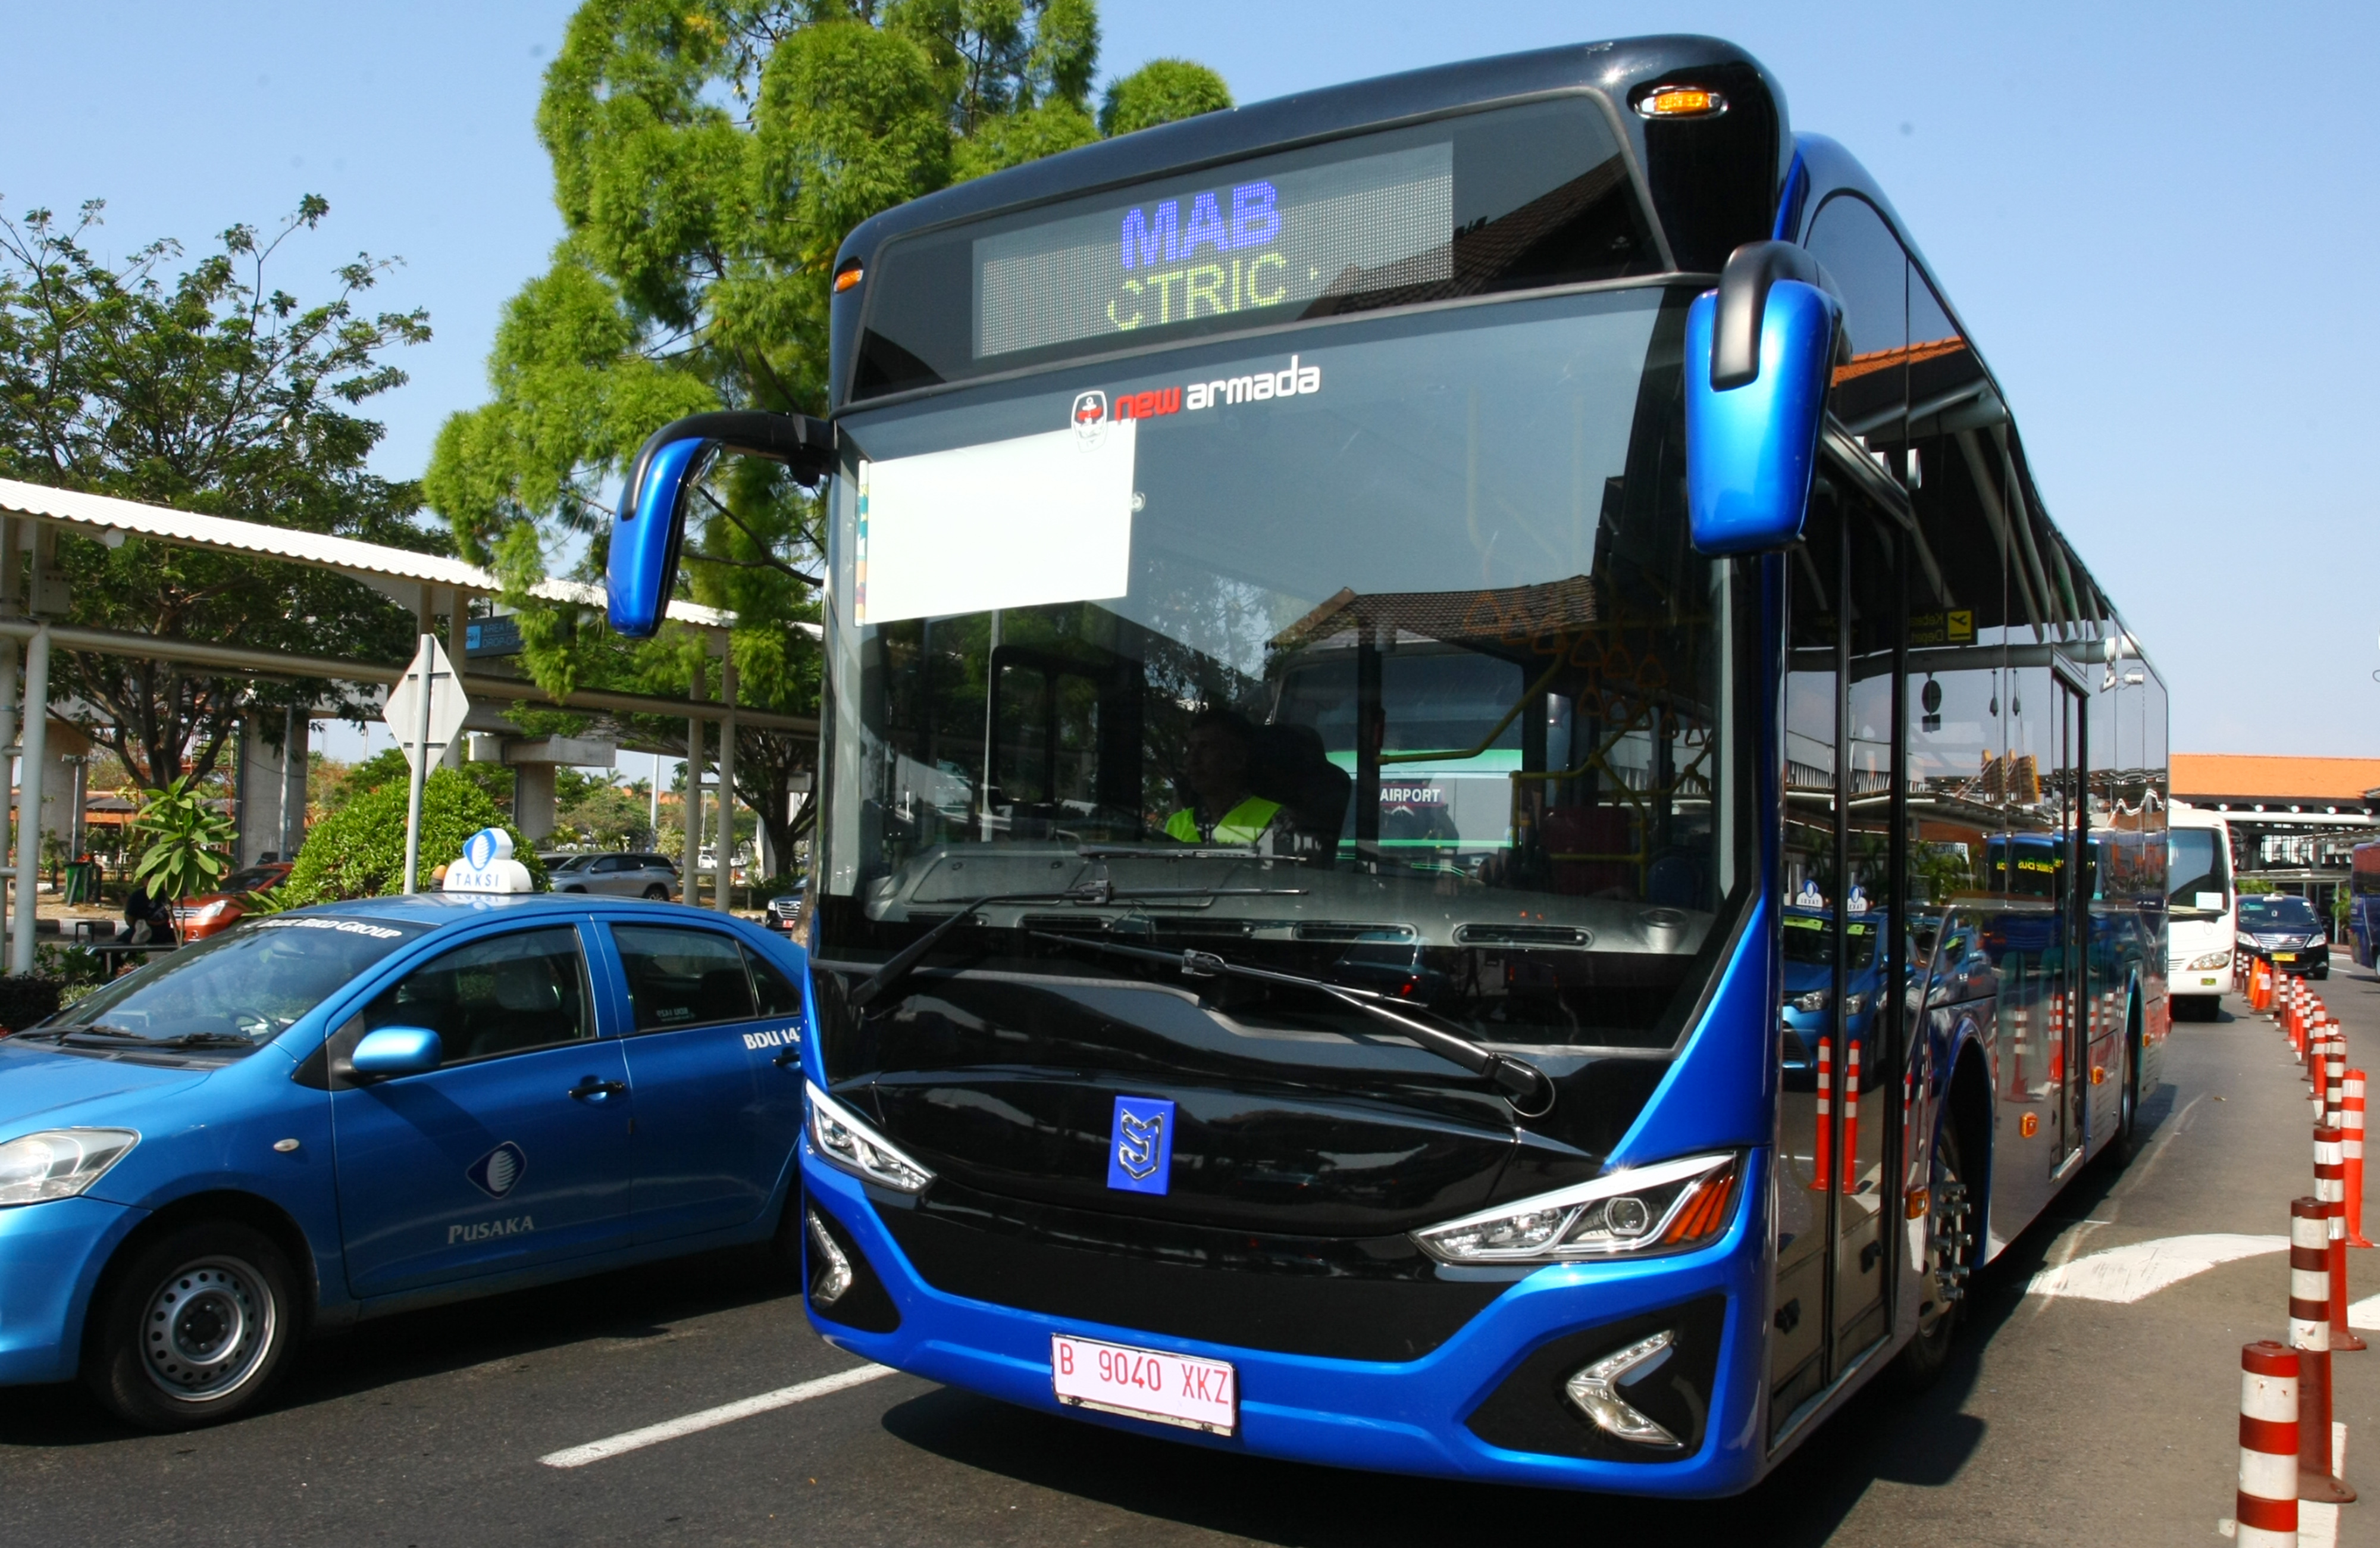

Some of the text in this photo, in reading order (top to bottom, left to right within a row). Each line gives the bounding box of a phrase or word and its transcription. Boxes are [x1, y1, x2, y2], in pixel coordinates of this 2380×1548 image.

[1120, 180, 1282, 270] MAB
[1114, 355, 1320, 423] new armada
[1380, 788, 1440, 802] AIRPORT
[456, 872, 499, 887] TAKSI
[335, 922, 402, 939] GROUP
[743, 1031, 782, 1049] BDU
[447, 1215, 534, 1244] PUSAKA
[1060, 1343, 1229, 1405] B 9040 XKZ
